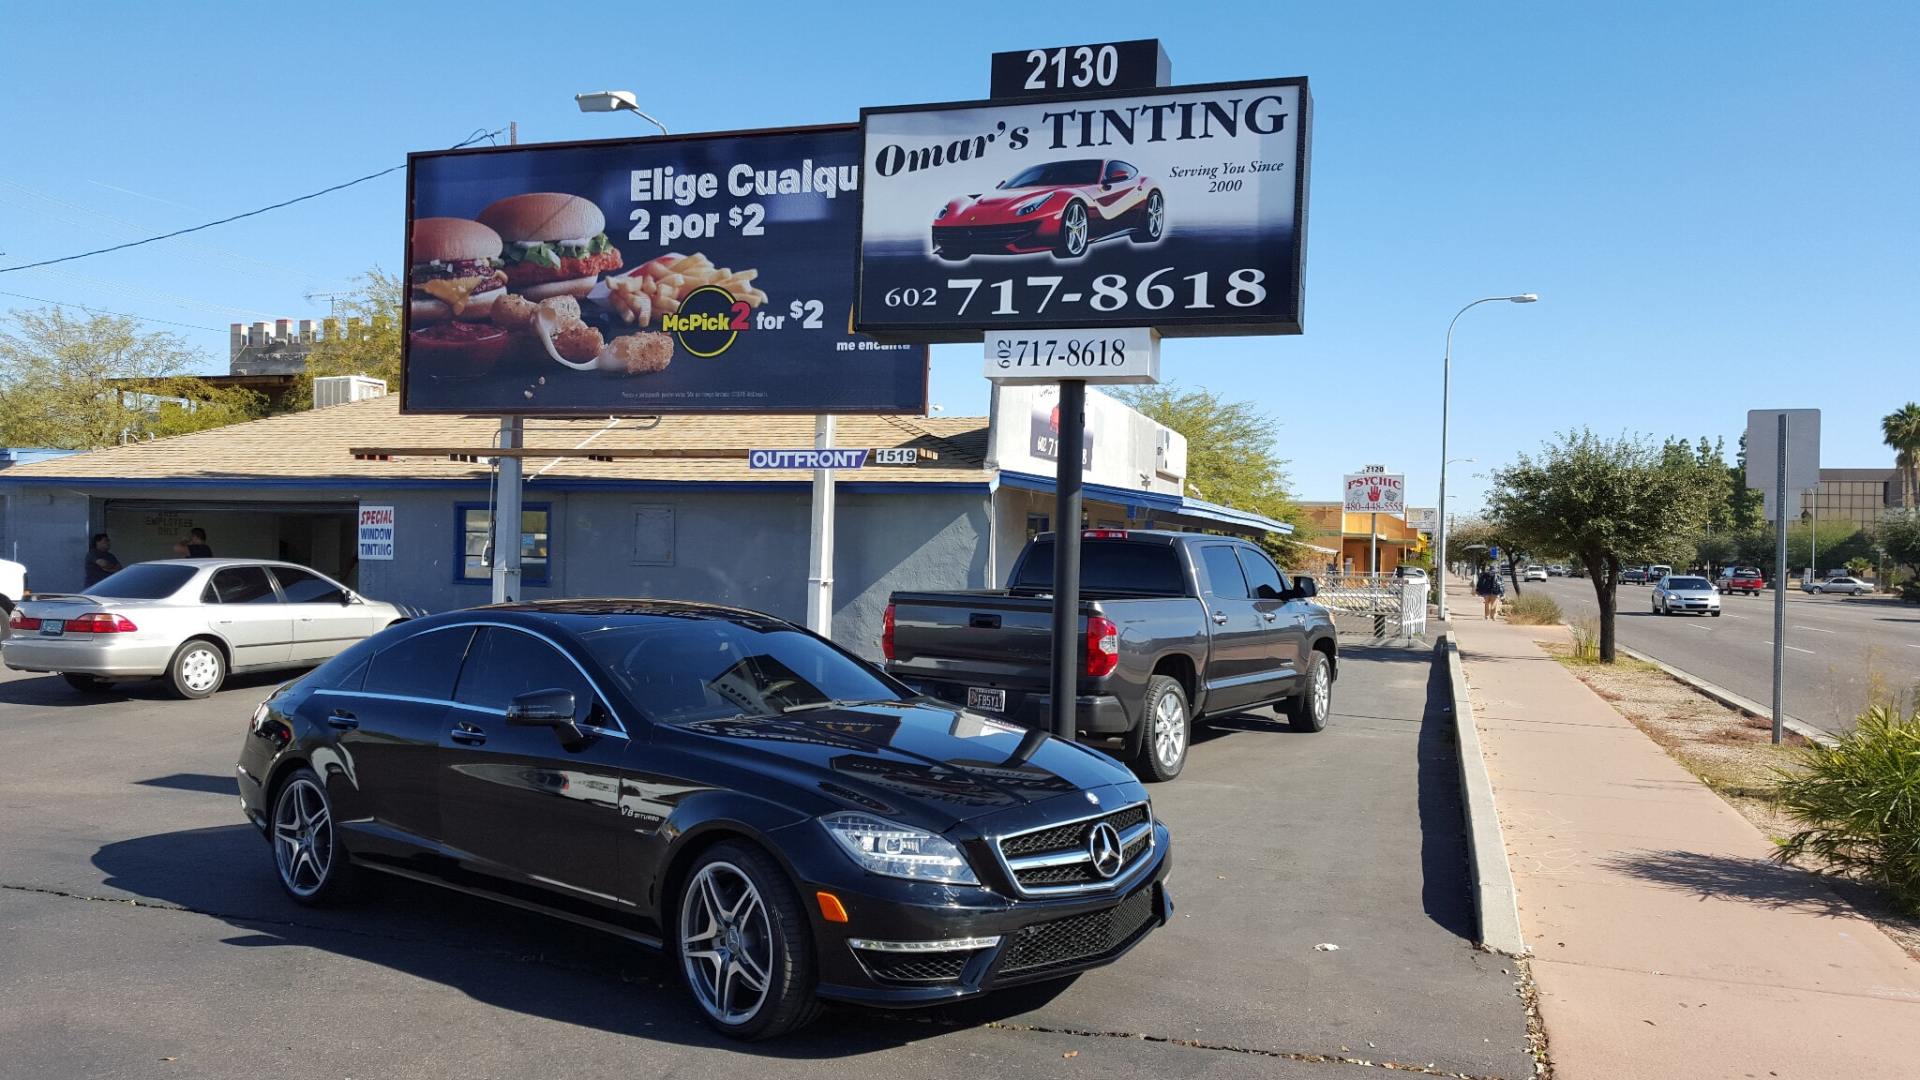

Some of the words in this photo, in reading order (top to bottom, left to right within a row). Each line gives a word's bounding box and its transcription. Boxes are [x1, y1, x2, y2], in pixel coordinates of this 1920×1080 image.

[1024, 44, 1118, 91] 2130
[874, 120, 1029, 178] Omar's
[1041, 95, 1289, 150] TINTING
[1169, 165, 1219, 180] Serving
[1223, 162, 1246, 175] You
[1248, 160, 1285, 173] Since
[630, 165, 719, 206] Elige
[1208, 179, 1243, 193] 2000
[628, 208, 650, 241] 2
[659, 212, 720, 247] por
[728, 202, 765, 237] $2
[884, 286, 937, 308] 602
[946, 267, 1267, 317] 717-8618
[756, 311, 785, 331] for
[789, 298, 825, 330] $2
[836, 341, 856, 351] me
[997, 340, 1011, 368] 602
[1016, 339, 1126, 367] 717-8618
[752, 451, 862, 468] OUTFRONT
[877, 449, 916, 464] 1519
[1348, 476, 1401, 489] PSYCHIC
[361, 510, 392, 525] SPECIAL
[361, 528, 391, 540] WINDOW
[361, 544, 391, 555] TINTING
[621, 807, 633, 817] V8
